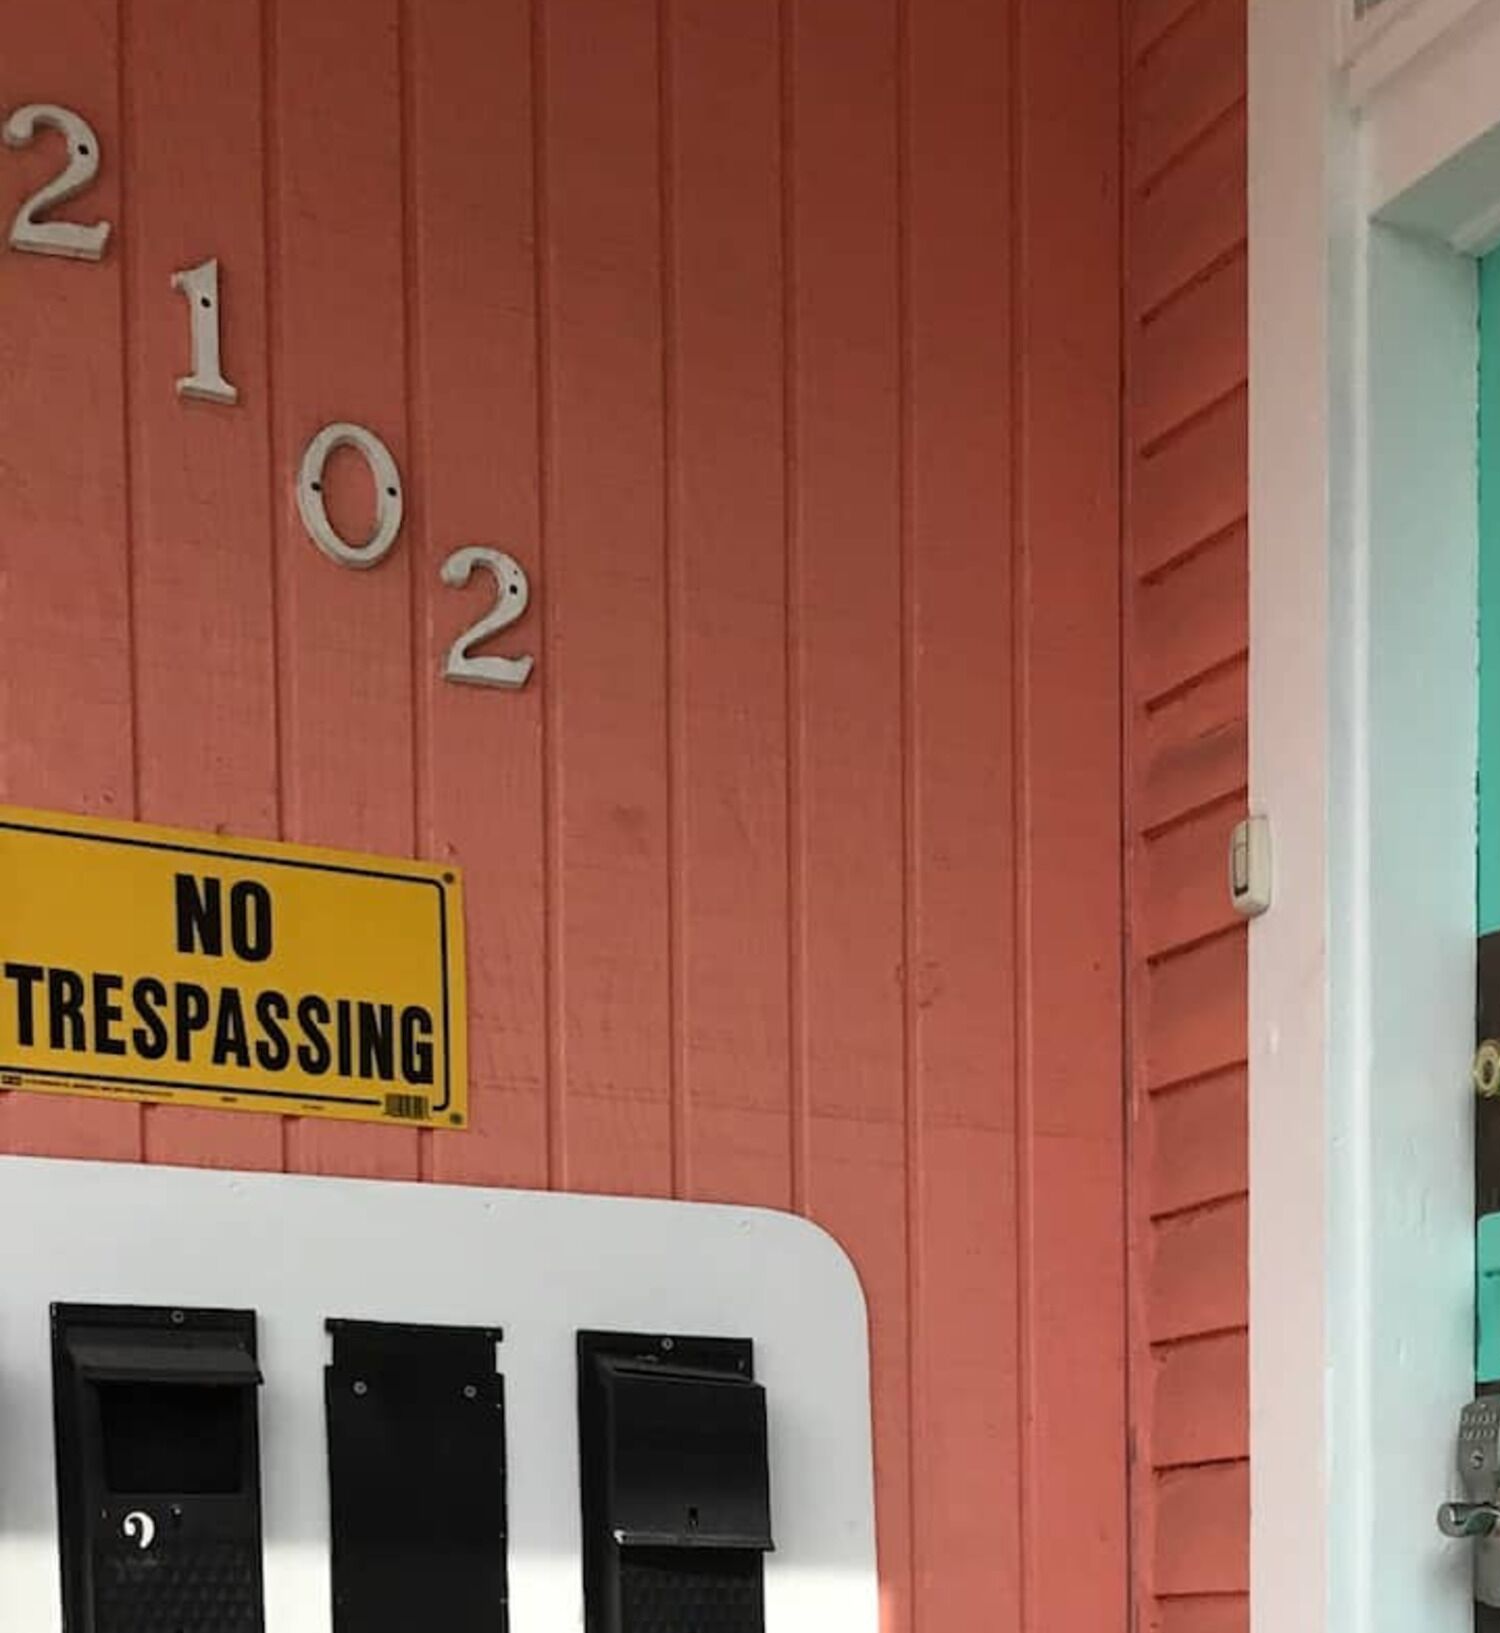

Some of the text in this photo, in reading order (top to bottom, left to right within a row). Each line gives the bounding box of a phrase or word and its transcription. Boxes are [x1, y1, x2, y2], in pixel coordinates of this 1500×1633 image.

[3, 103, 534, 688] 2102
[174, 872, 273, 963] NO
[4, 961, 435, 1085] TRESPASSING
